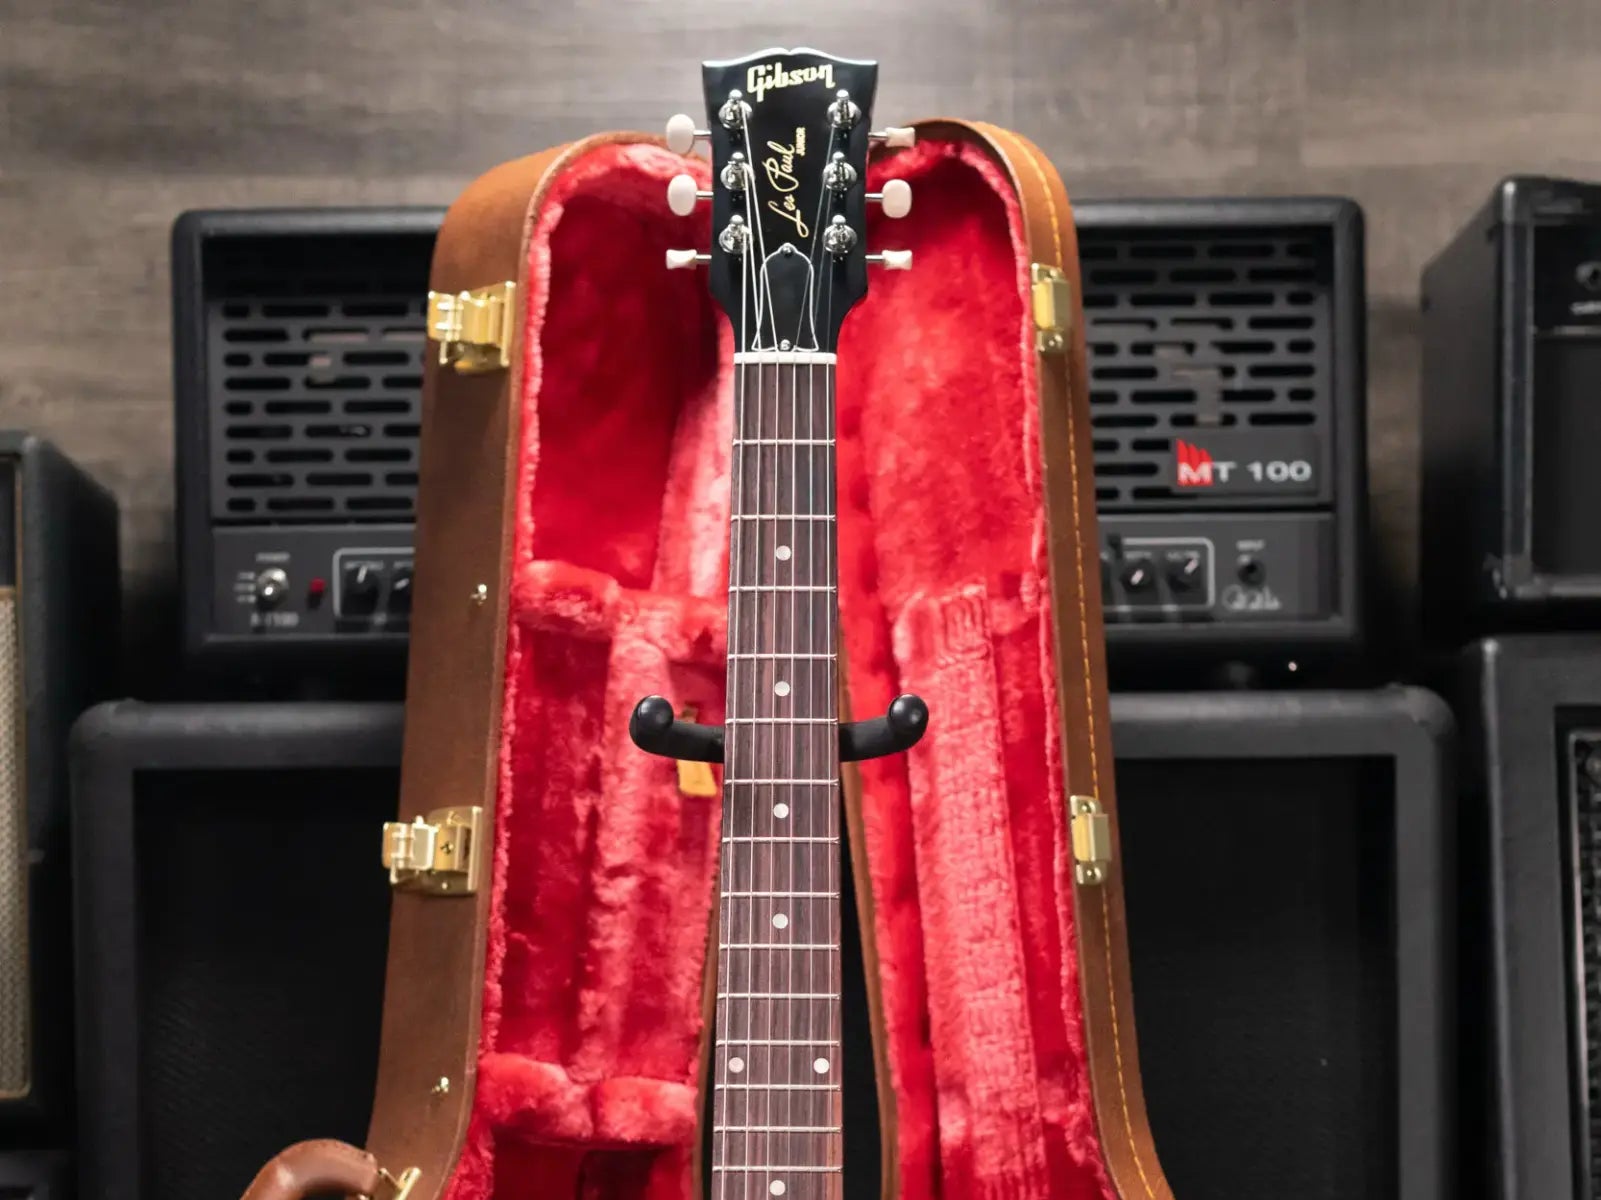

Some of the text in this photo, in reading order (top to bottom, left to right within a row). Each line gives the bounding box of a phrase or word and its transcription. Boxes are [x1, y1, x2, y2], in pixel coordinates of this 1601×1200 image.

[747, 62, 836, 102] Gibson
[762, 140, 809, 238] Les Paul
[1178, 461, 1312, 482] MT 100
